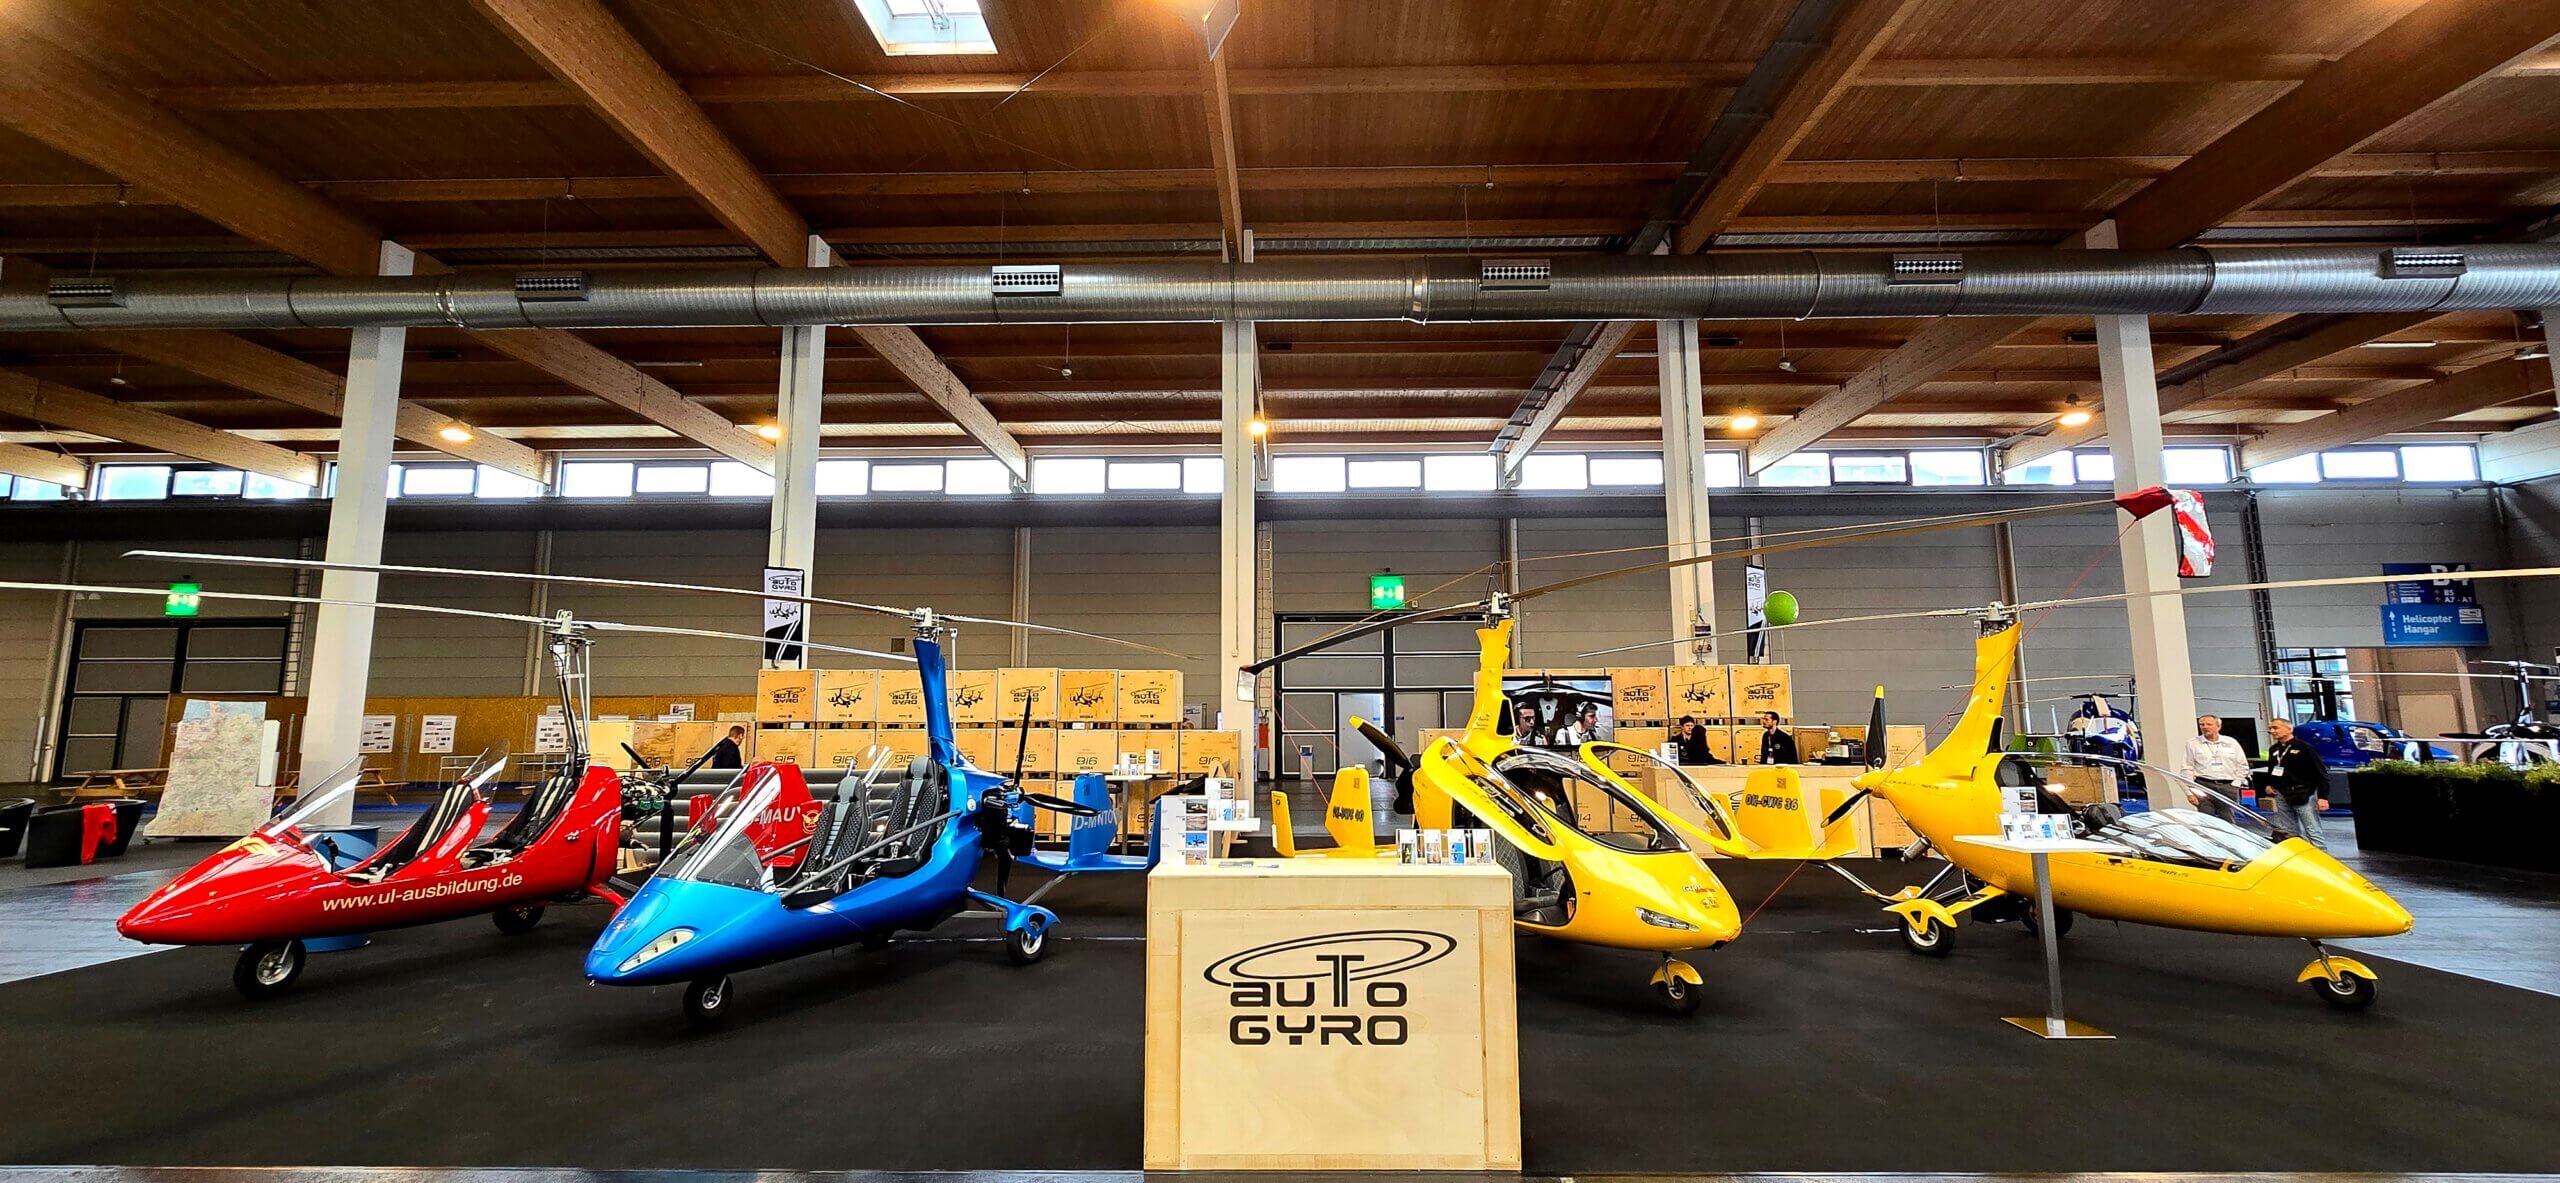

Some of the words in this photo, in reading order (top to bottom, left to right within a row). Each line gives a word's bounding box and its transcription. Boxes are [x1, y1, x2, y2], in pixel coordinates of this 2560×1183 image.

[2402, 614, 2454, 624] Helicopter
[2403, 625, 2440, 636] Hangar
[774, 755, 796, 764] 915
[1016, 753, 1037, 763] 15
[1075, 756, 1098, 766] 916
[1784, 796, 1799, 811] 36
[751, 805, 801, 825] -MAU
[322, 872, 524, 912] www.ul-ausbildung.de
[1230, 1015, 1408, 1046] GYRO
